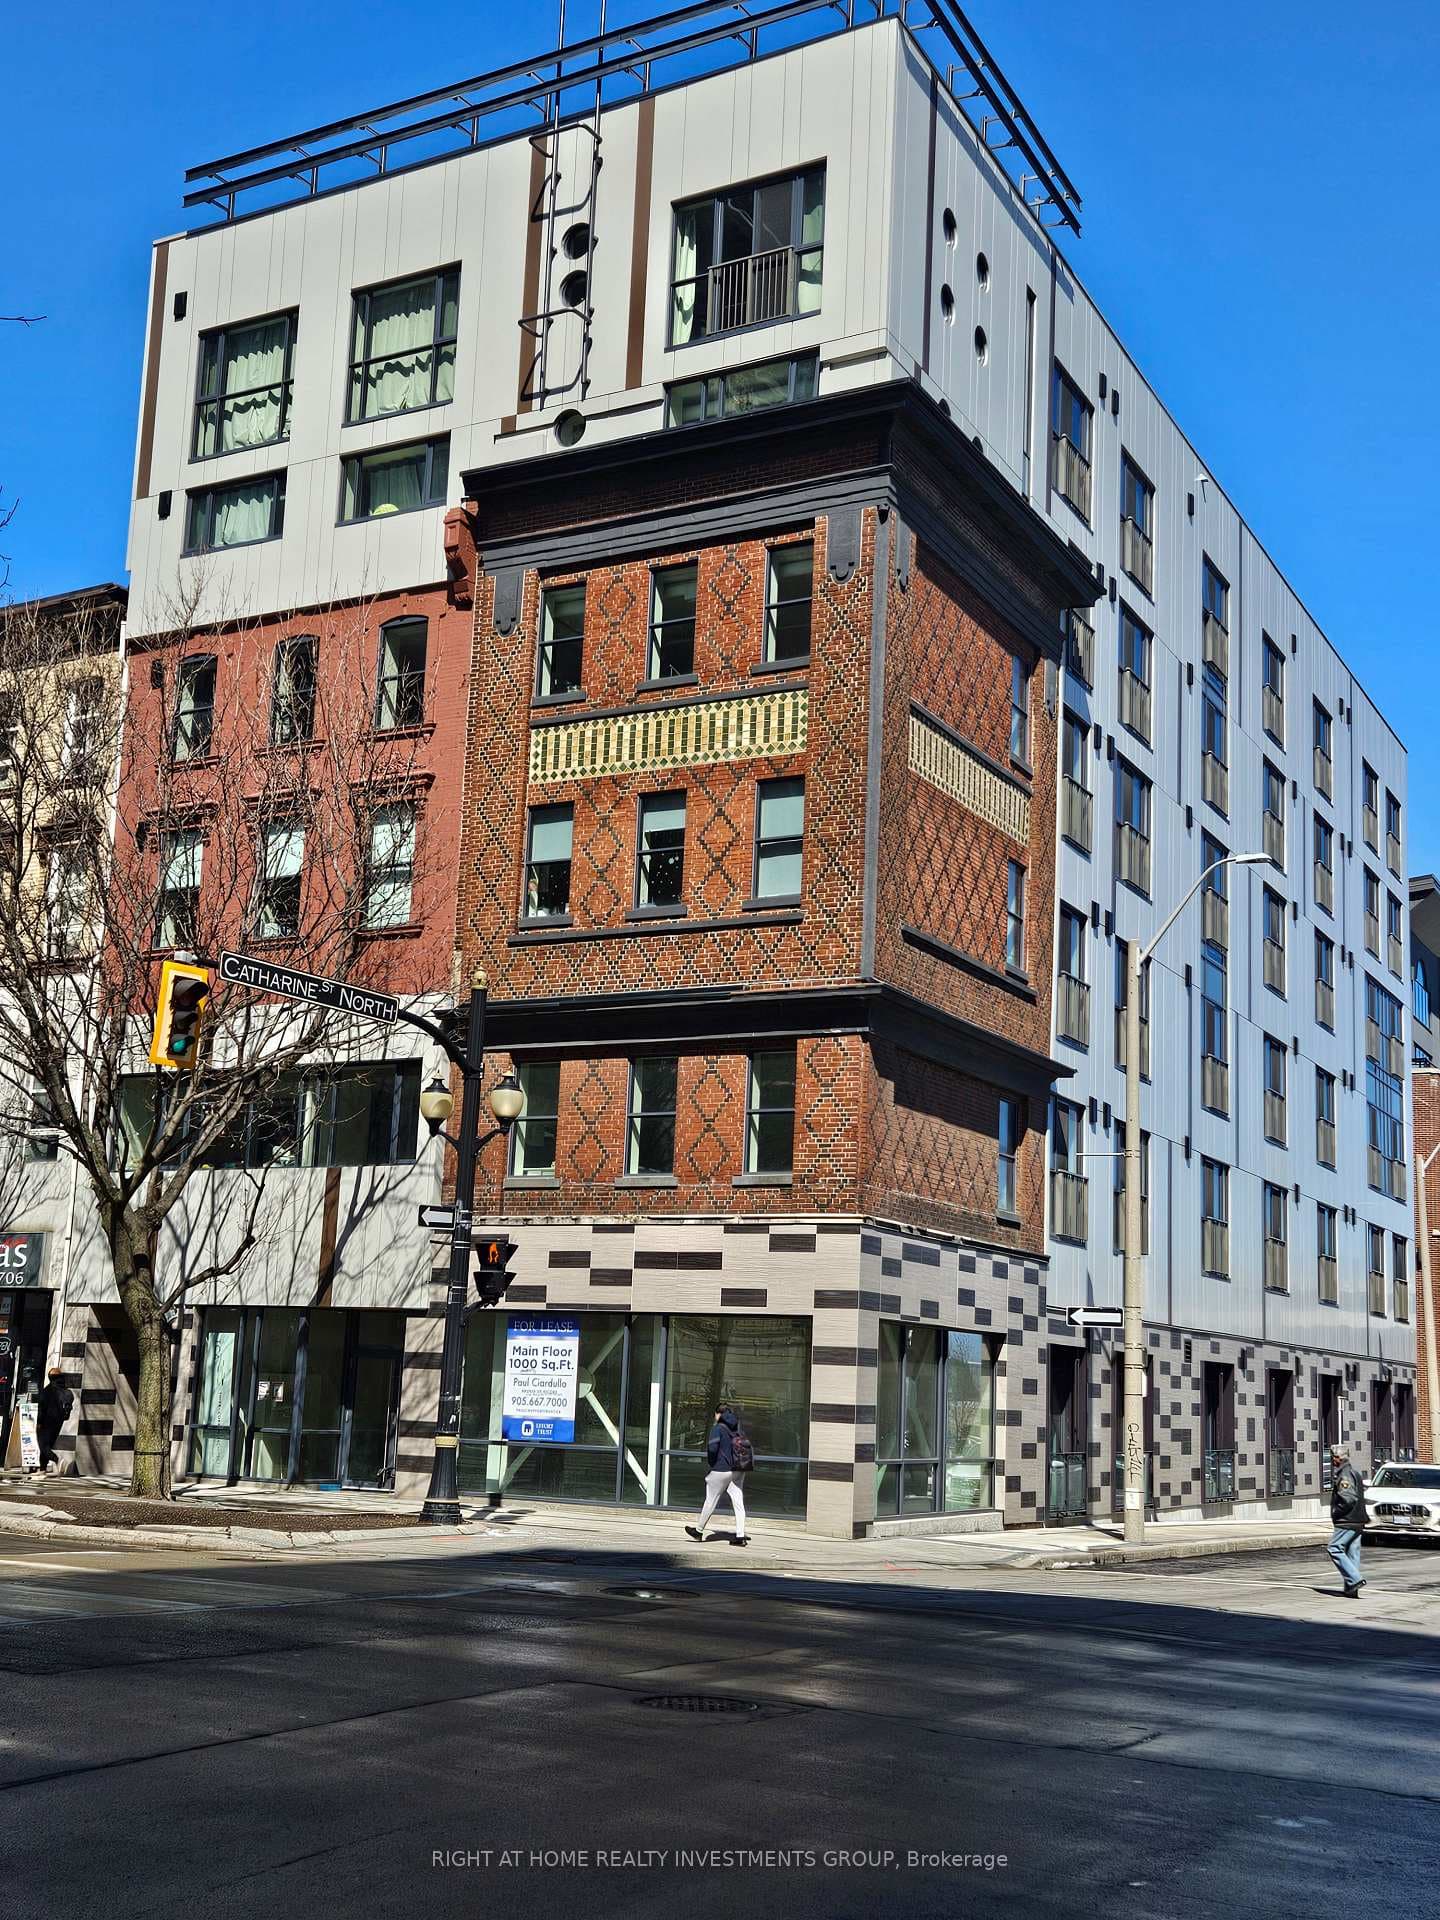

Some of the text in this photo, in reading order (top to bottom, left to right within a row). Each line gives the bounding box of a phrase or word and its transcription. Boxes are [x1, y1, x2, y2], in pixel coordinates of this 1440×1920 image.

[224, 957, 319, 999] CATHARINE
[339, 987, 394, 1020] NORTH
[513, 1320, 574, 1333] FOR LEASE
[512, 1344, 573, 1357] Main Floor
[509, 1358, 538, 1369] 1000
[541, 1359, 575, 1372] Sq.Ft.
[513, 1377, 530, 1387] Paul
[511, 1397, 568, 1408] 905.667.7000
